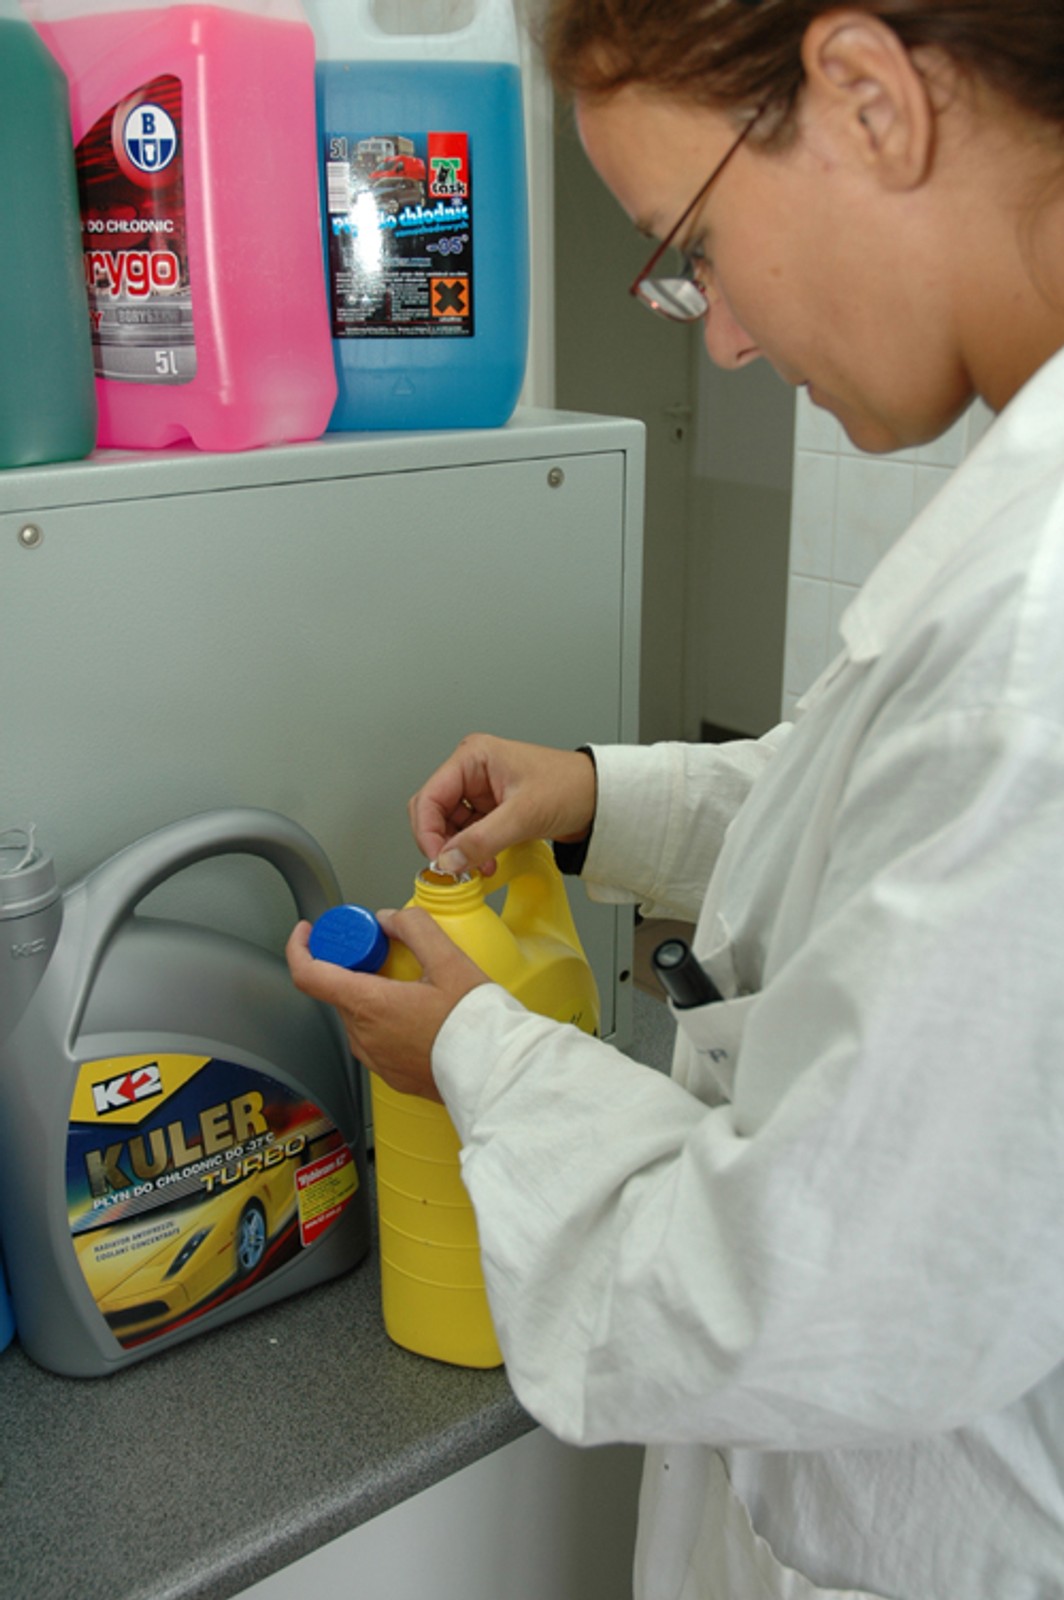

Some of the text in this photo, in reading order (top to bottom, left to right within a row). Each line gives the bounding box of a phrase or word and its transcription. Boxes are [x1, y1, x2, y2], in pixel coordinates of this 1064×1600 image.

[87, 219, 104, 232] DO
[92, 1063, 163, 1114] K2
[85, 1091, 269, 1198] KULER
[200, 1134, 307, 1194] TURBO
[132, 1182, 154, 1197] DO
[225, 1145, 244, 1162] DO
